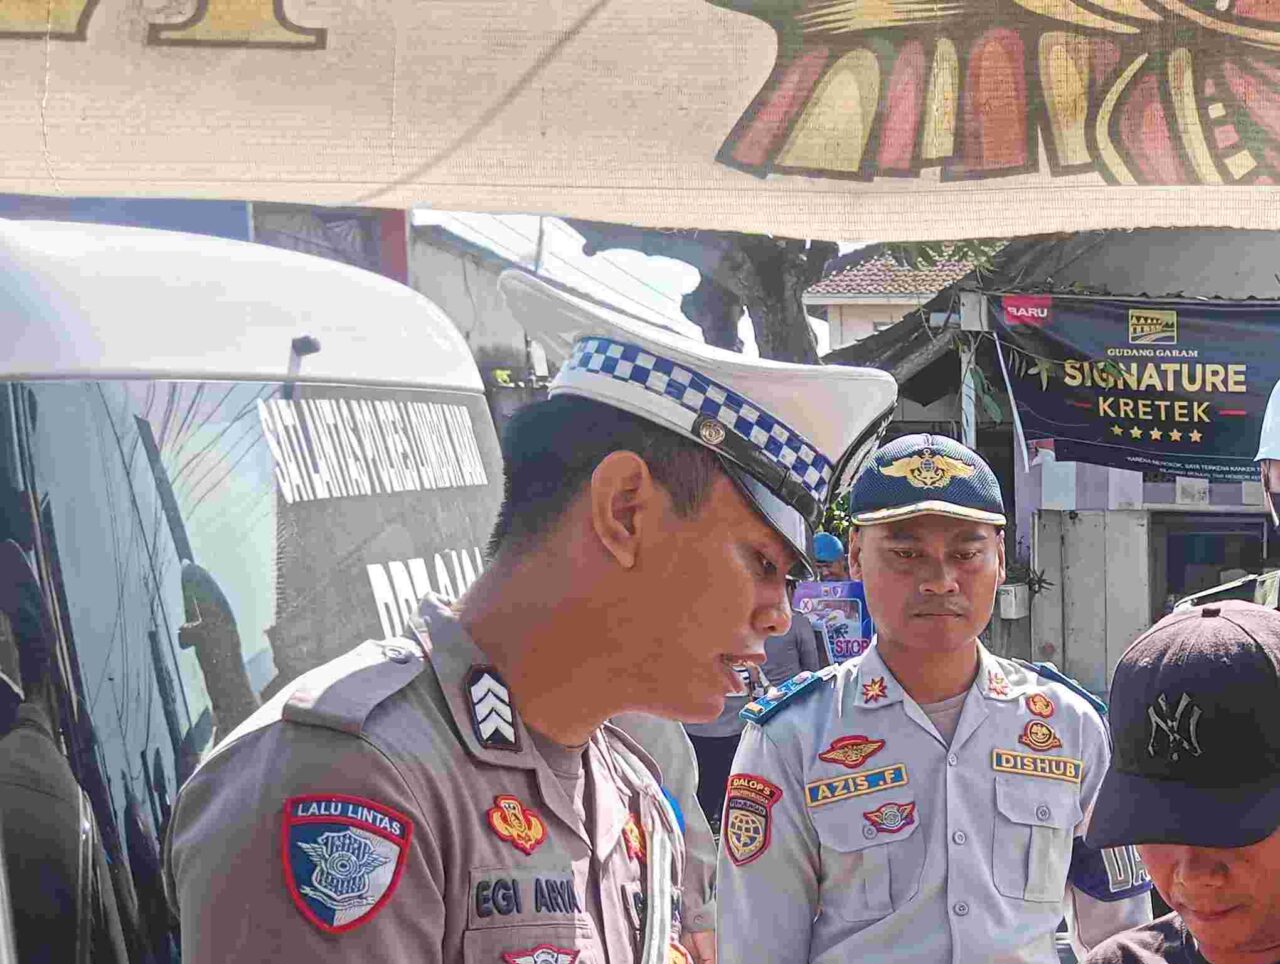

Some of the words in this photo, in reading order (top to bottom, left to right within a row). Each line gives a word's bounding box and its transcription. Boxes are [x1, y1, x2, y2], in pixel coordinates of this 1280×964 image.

[1108, 348, 1154, 357] GUDANG
[1156, 349, 1199, 358] GARAM
[1063, 359, 1247, 393] SIGNATURE
[1098, 396, 1212, 423] KRETEK
[1001, 754, 1076, 777] DISHUB
[817, 776, 869, 801] AZIS
[297, 801, 341, 817] LALU
[347, 803, 401, 836] LINTAS
[476, 879, 522, 918] EGI
